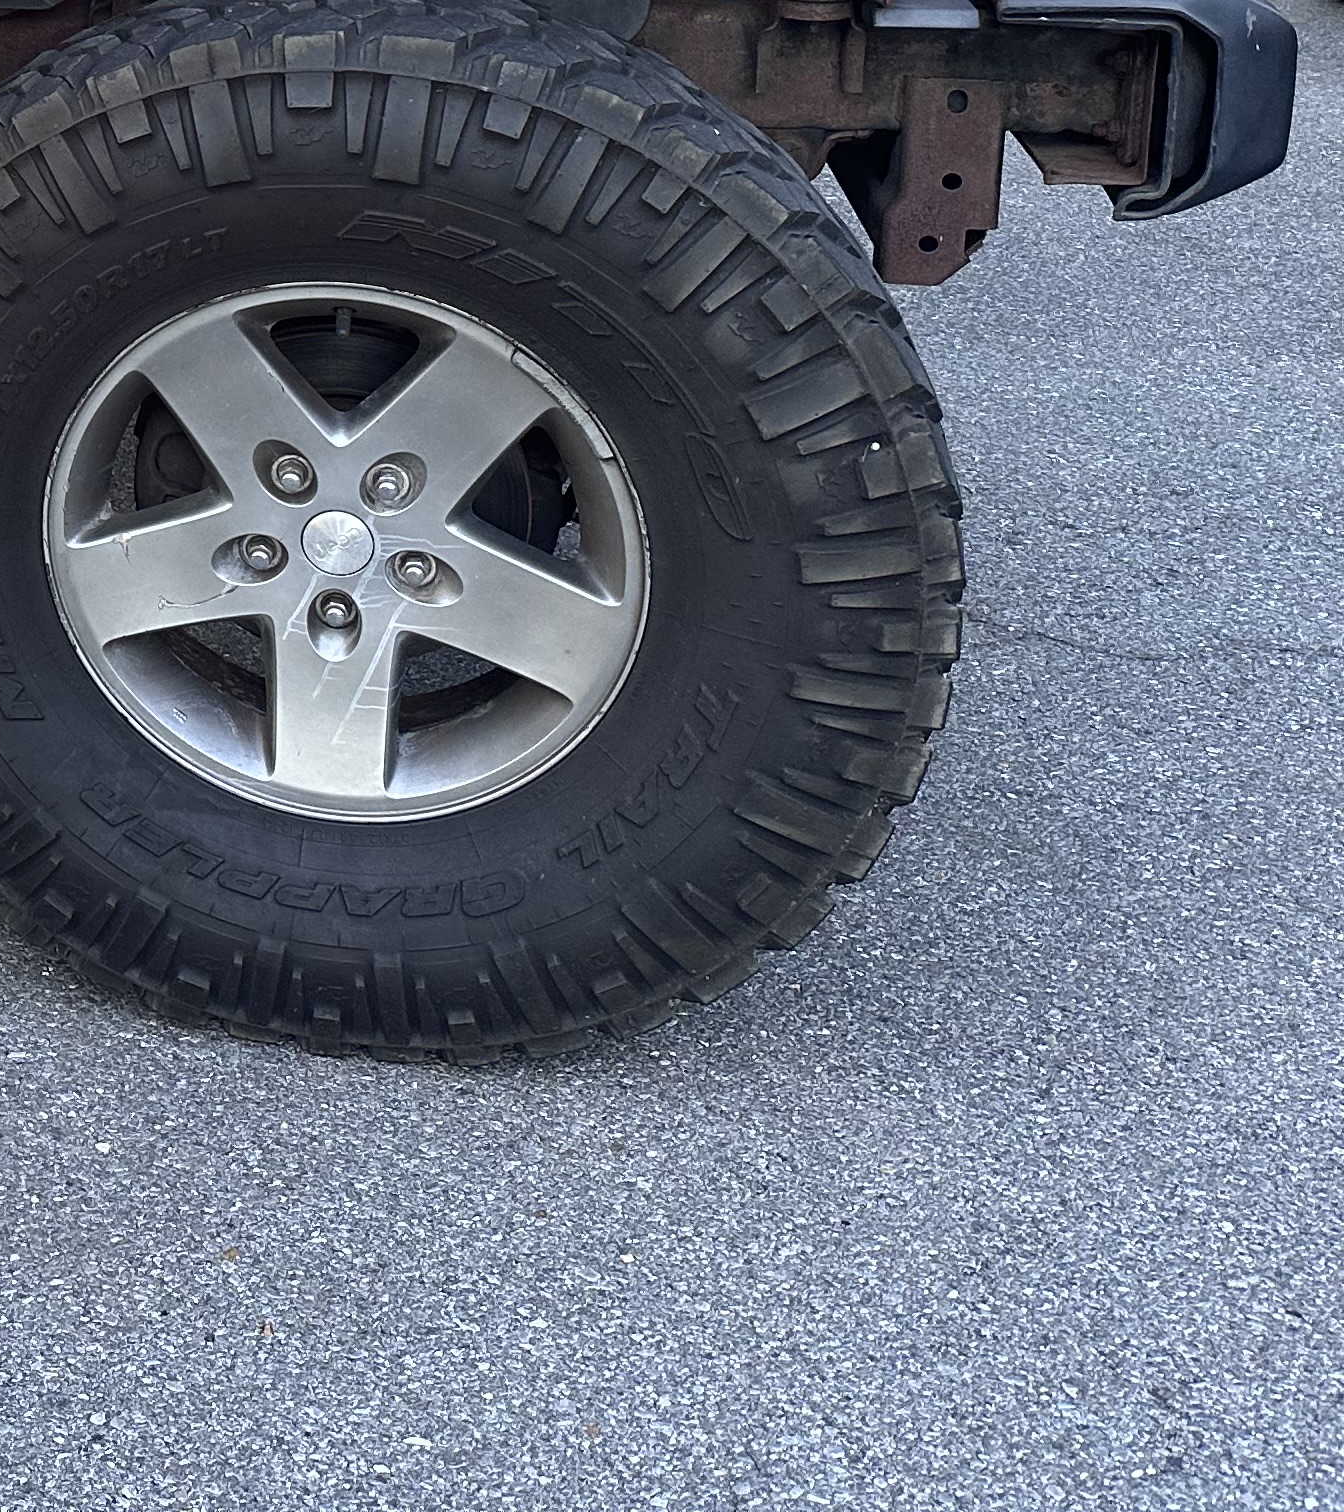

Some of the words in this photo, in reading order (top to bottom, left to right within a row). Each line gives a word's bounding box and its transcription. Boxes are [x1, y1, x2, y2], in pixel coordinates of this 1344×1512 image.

[337, 209, 752, 541] NITTO
[312, 527, 364, 562] Jeep
[79, 782, 527, 919] GRAPPLER
[557, 682, 740, 869] TRAIL
